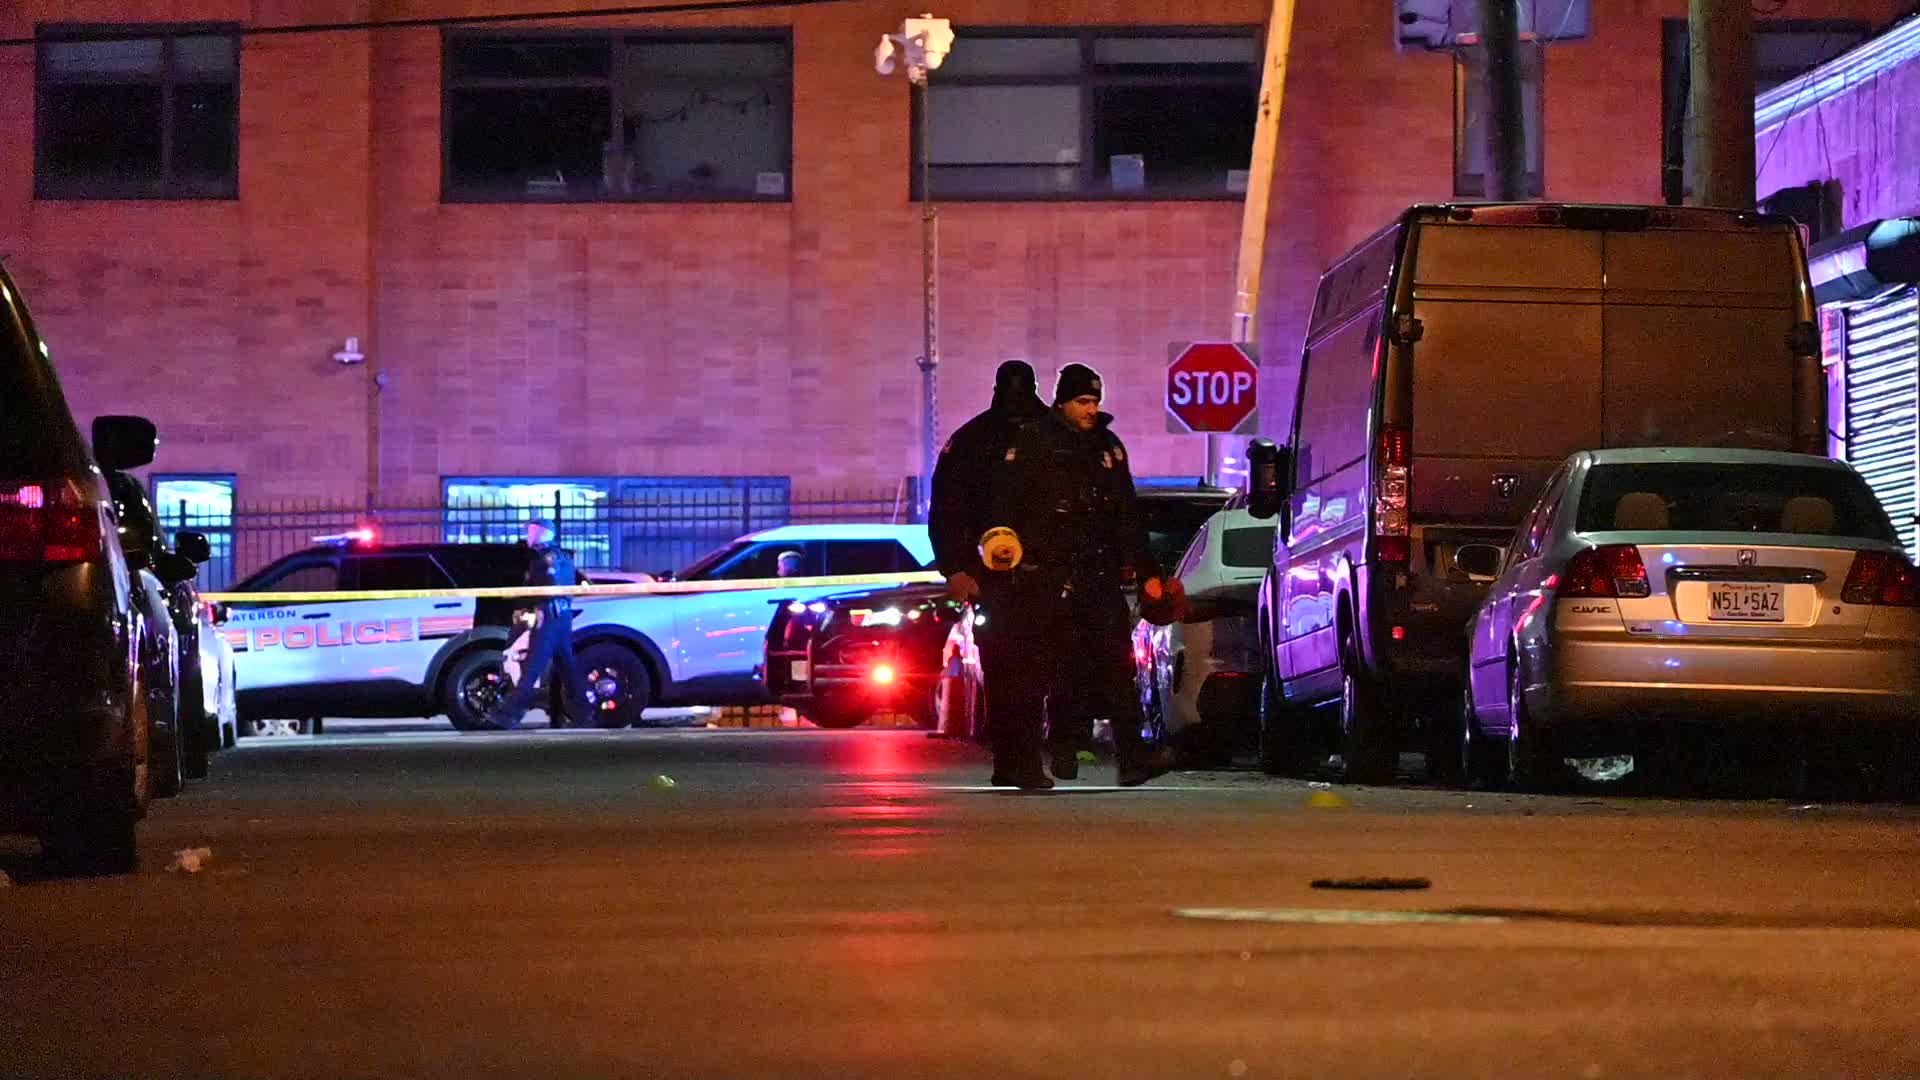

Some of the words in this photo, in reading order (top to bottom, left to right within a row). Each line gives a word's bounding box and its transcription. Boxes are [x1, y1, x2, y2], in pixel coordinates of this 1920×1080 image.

[1172, 370, 1252, 405] STOP
[231, 610, 297, 623] ATERSON
[253, 619, 413, 652] POLICE
